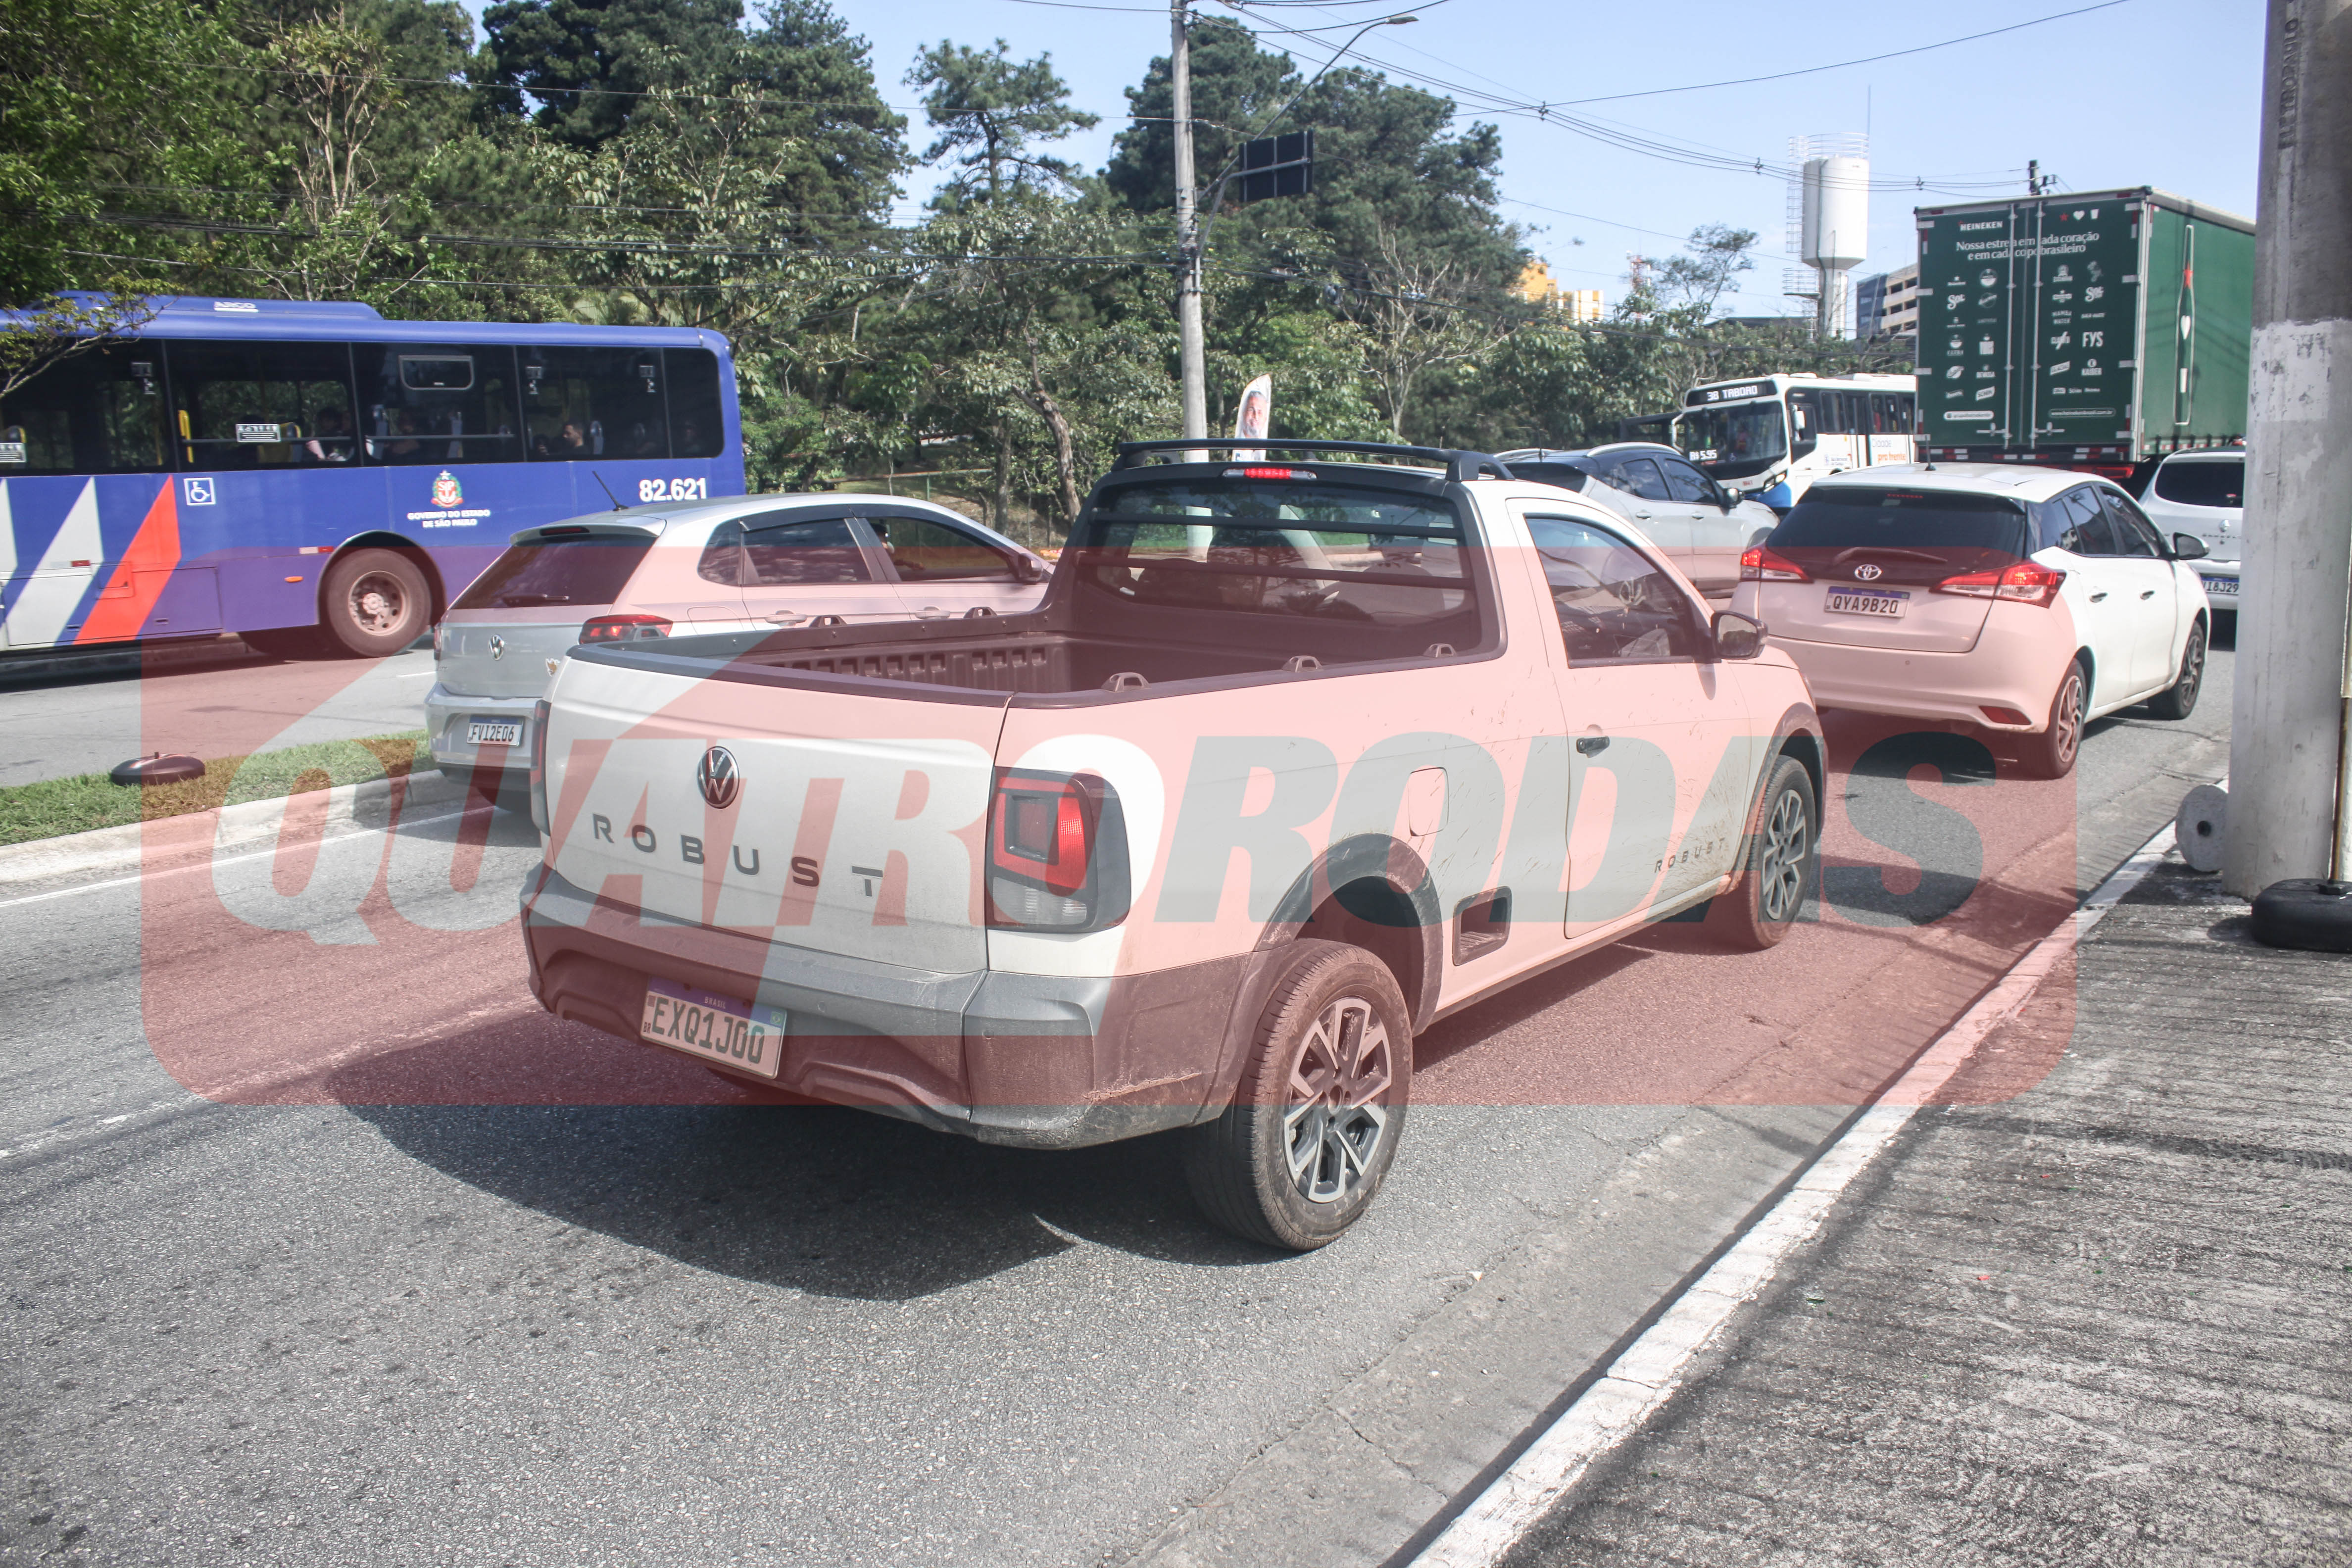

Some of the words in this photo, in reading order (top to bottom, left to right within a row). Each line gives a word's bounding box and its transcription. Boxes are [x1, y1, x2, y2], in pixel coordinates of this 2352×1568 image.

[1960, 221, 2003, 231] HEINEKEN
[1956, 241, 1985, 251] Nossa
[1986, 239, 2017, 248] estrea
[2018, 238, 2035, 246] em
[2041, 234, 2059, 245] ada
[2059, 231, 2100, 245] coração
[1974, 251, 1990, 260] em
[2040, 244, 2086, 255] brasileiro
[2082, 331, 2104, 347] FYS
[1706, 391, 1719, 402] 38
[639, 478, 707, 502] 82.621
[407, 511, 447, 520] GOVERNO
[461, 509, 491, 517] ESTADO
[435, 518, 451, 527] SÃO
[451, 518, 478, 526] PAULO
[1833, 595, 1899, 614] QYA9B20
[471, 724, 514, 742] FVI2E06
[592, 813, 884, 897] ROBUST
[1654, 837, 1725, 873] ROBUST
[704, 996, 726, 1010] BRASIL
[643, 1021, 651, 1034] BR
[651, 996, 766, 1065] EXQ1J00
